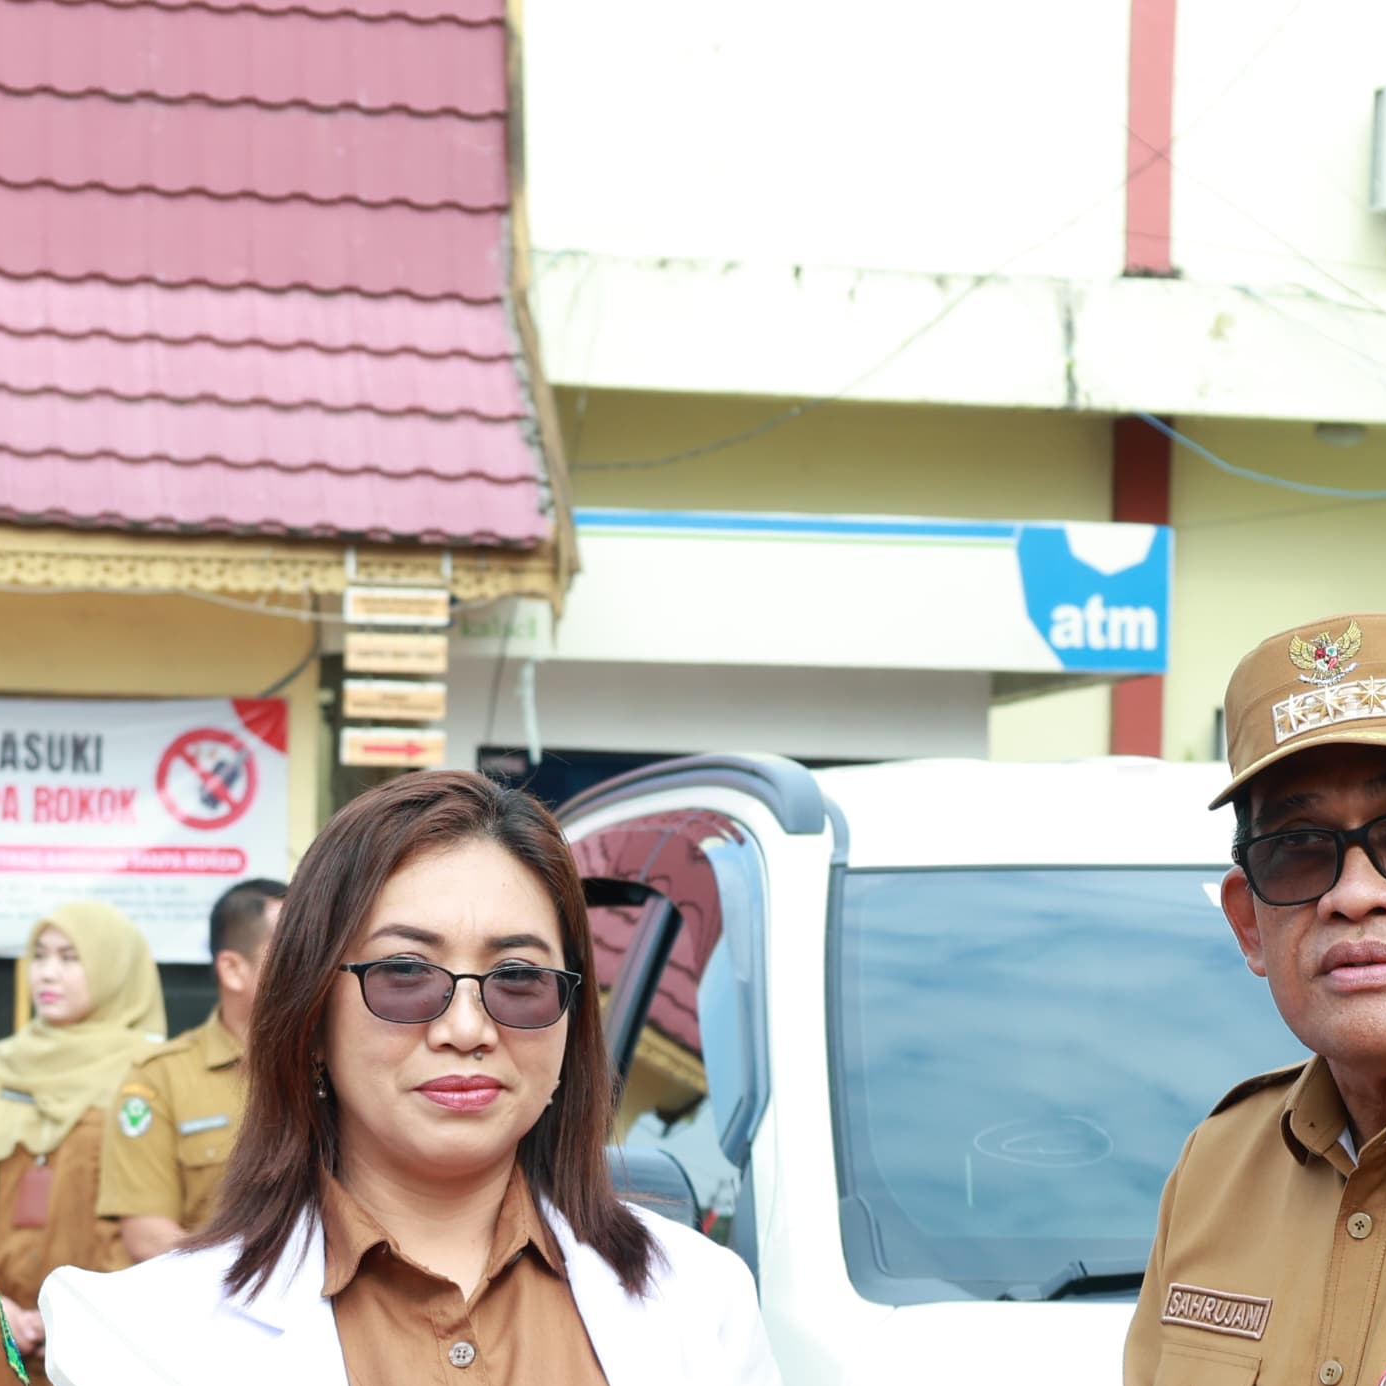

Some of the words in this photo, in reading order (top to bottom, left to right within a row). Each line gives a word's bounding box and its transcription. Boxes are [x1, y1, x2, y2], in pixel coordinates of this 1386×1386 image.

[1050, 592, 1158, 651] atm
[33, 786, 137, 825] ROKOK
[1168, 1291, 1264, 1331] SAHRUJANI
